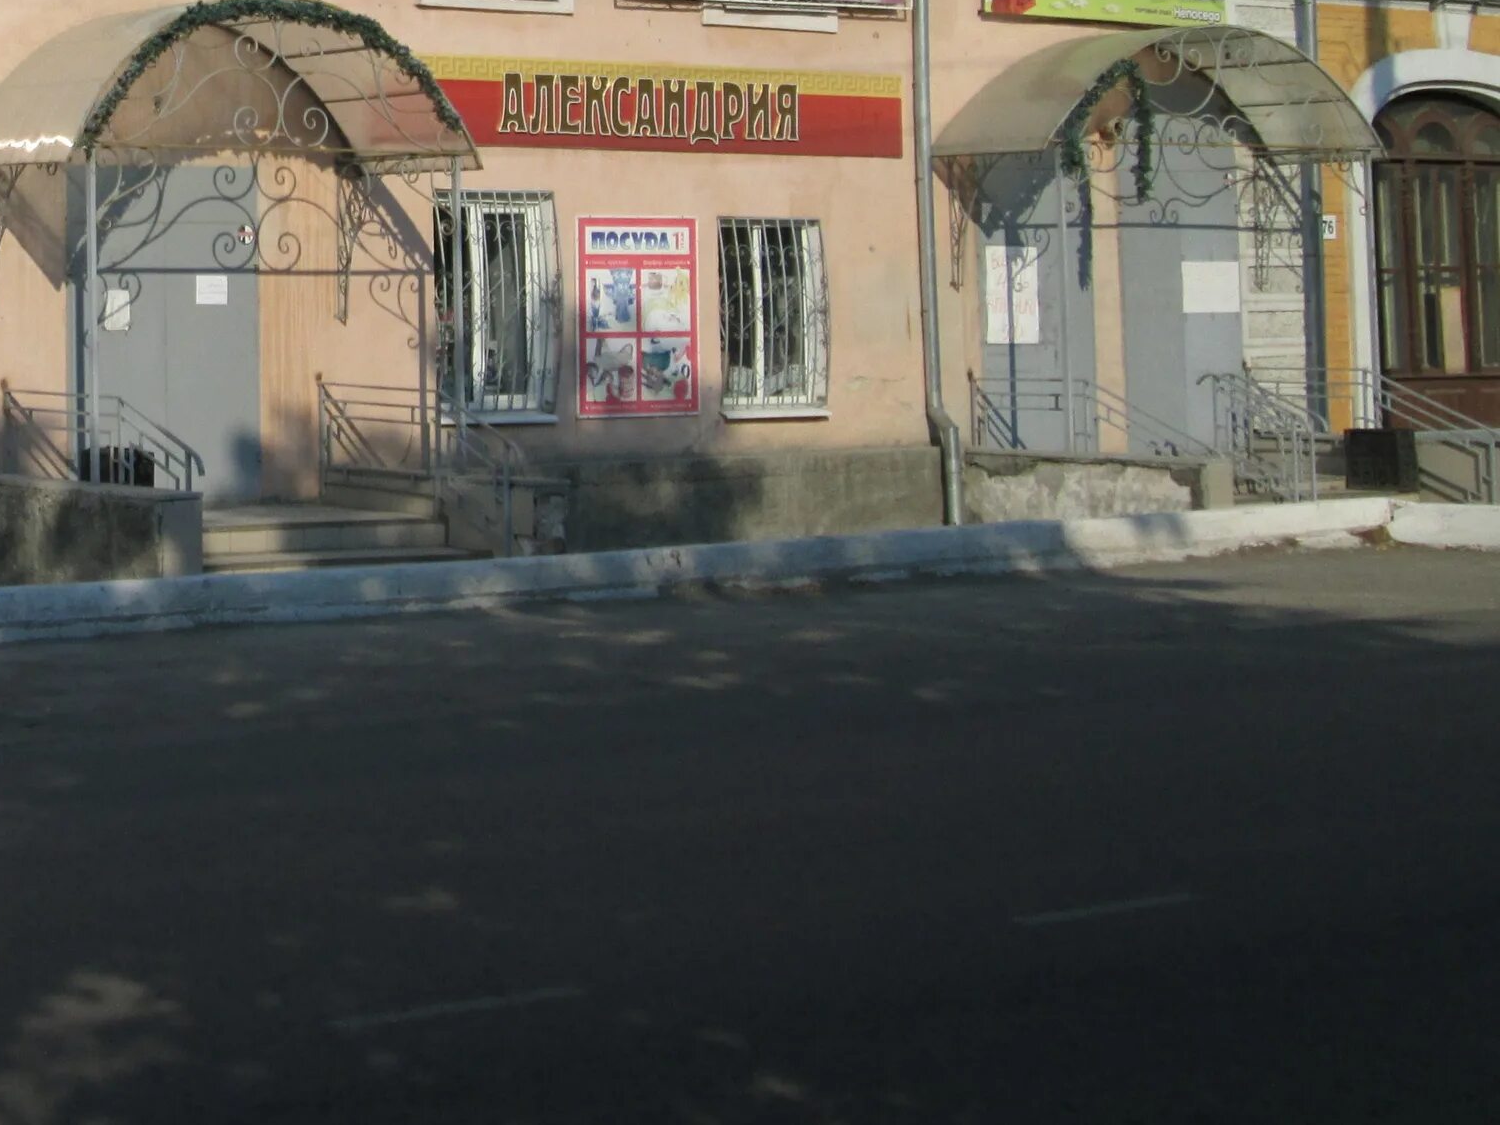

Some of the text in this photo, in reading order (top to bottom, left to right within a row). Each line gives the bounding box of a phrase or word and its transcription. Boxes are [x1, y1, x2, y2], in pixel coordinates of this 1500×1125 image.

[497, 72, 800, 145] АЛЕКСАНДРИЯ
[590, 231, 670, 251] ПОСУДА
[672, 232, 680, 250] 1
